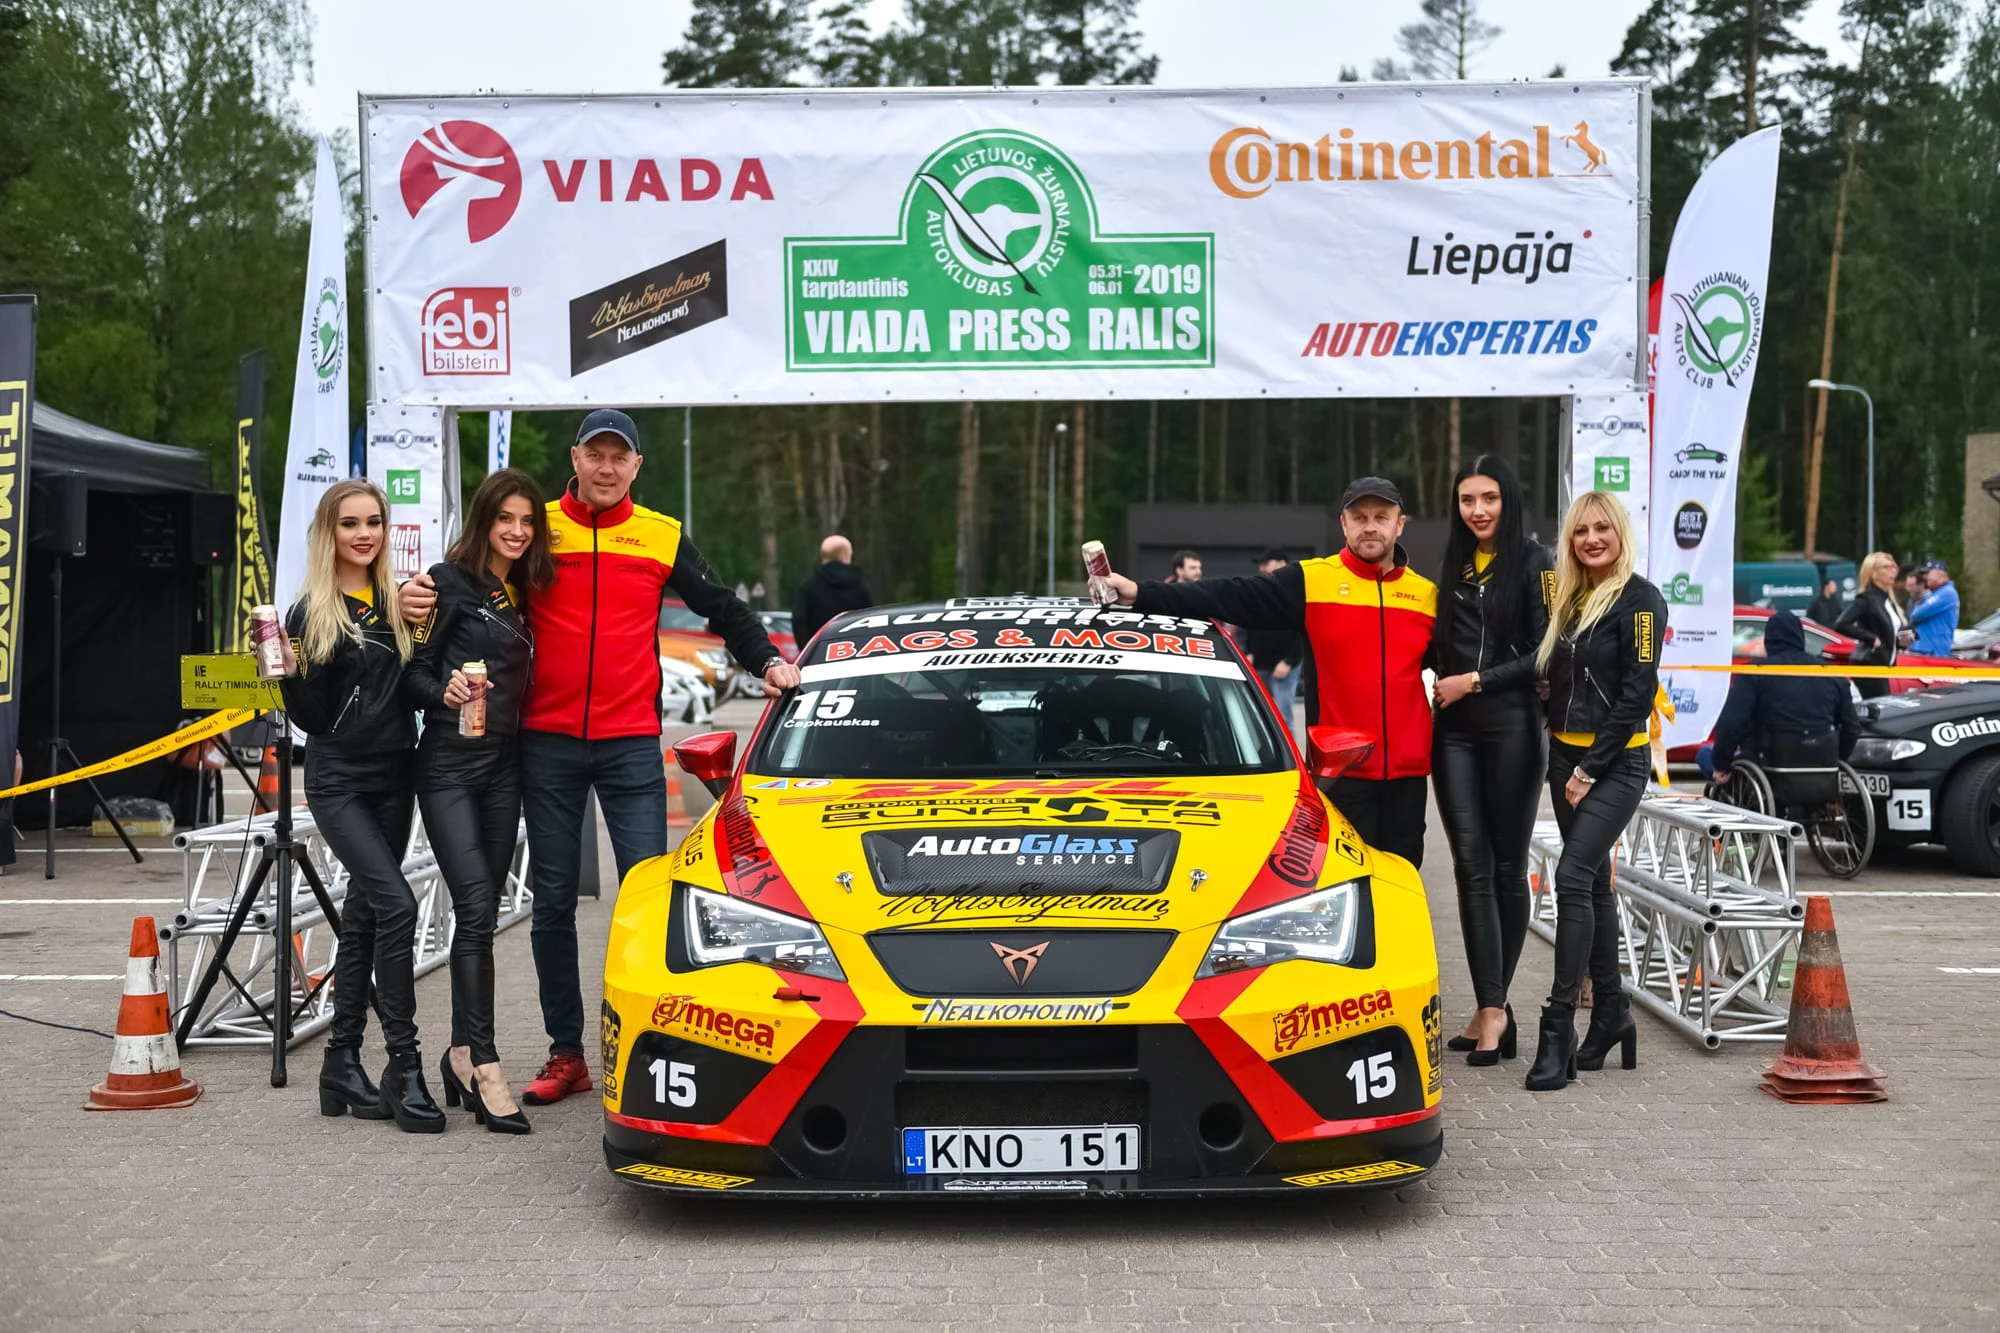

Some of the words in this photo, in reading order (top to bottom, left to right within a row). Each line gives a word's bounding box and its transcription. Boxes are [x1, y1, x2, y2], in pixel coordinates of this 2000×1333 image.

[952, 146, 1037, 177] LIETUVOS
[1209, 124, 1554, 200] Continental
[542, 157, 775, 202] VIADA
[926, 208, 1013, 296] AUTOKLUBAS
[1406, 229, 1573, 285] Liepāja
[802, 258, 838, 278] XXIV
[1134, 264, 1201, 295] 2019
[802, 277, 909, 300] tarptautinis
[1088, 281, 1122, 295] 06.01
[422, 289, 508, 351] febi
[803, 309, 932, 354] VIADA
[949, 308, 1071, 352] PRESS
[1088, 306, 1201, 351] RALIS
[1687, 271, 1750, 303] LITHUANIAN
[1731, 290, 1762, 380] JOURNALISTS
[1301, 318, 1598, 358] AUTOEKSPERTAS
[1674, 321, 1687, 366] AUTO
[433, 351, 499, 370] bilstein
[391, 477, 416, 497] 15
[1600, 464, 1626, 484] 15
[1693, 470, 1707, 479] THE
[1679, 511, 1704, 522] BEST
[615, 536, 641, 547] DHL
[393, 550, 420, 573] ild
[1396, 592, 1417, 601] DHL
[838, 607, 1214, 633] AutoGlass
[1015, 618, 1208, 636] SERVICE
[825, 628, 979, 662] BAGS
[993, 628, 1037, 648] &
[1050, 627, 1217, 659] MORE
[923, 651, 1124, 667] AUTOEKSPERTAS
[194, 680, 222, 689] RALLY
[225, 680, 258, 689] TIMING
[260, 680, 279, 690] SYS
[793, 689, 858, 720] 15
[1931, 716, 2000, 747] Contin
[848, 780, 1200, 799] DHL
[829, 801, 931, 811] CUSTOMS
[934, 797, 1018, 806] BROKER
[1893, 800, 1923, 820] 15
[906, 833, 1139, 858] AutoGlass
[1015, 855, 1135, 866] SERVICE
[1314, 1010, 1396, 1039] BATTERIES
[683, 1026, 773, 1056] BATTERIES
[648, 1058, 697, 1109] 15
[1345, 1050, 1397, 1105] 15
[906, 1156, 924, 1167] LT
[931, 1134, 1023, 1168] KNO
[1060, 1132, 1128, 1167] 151
